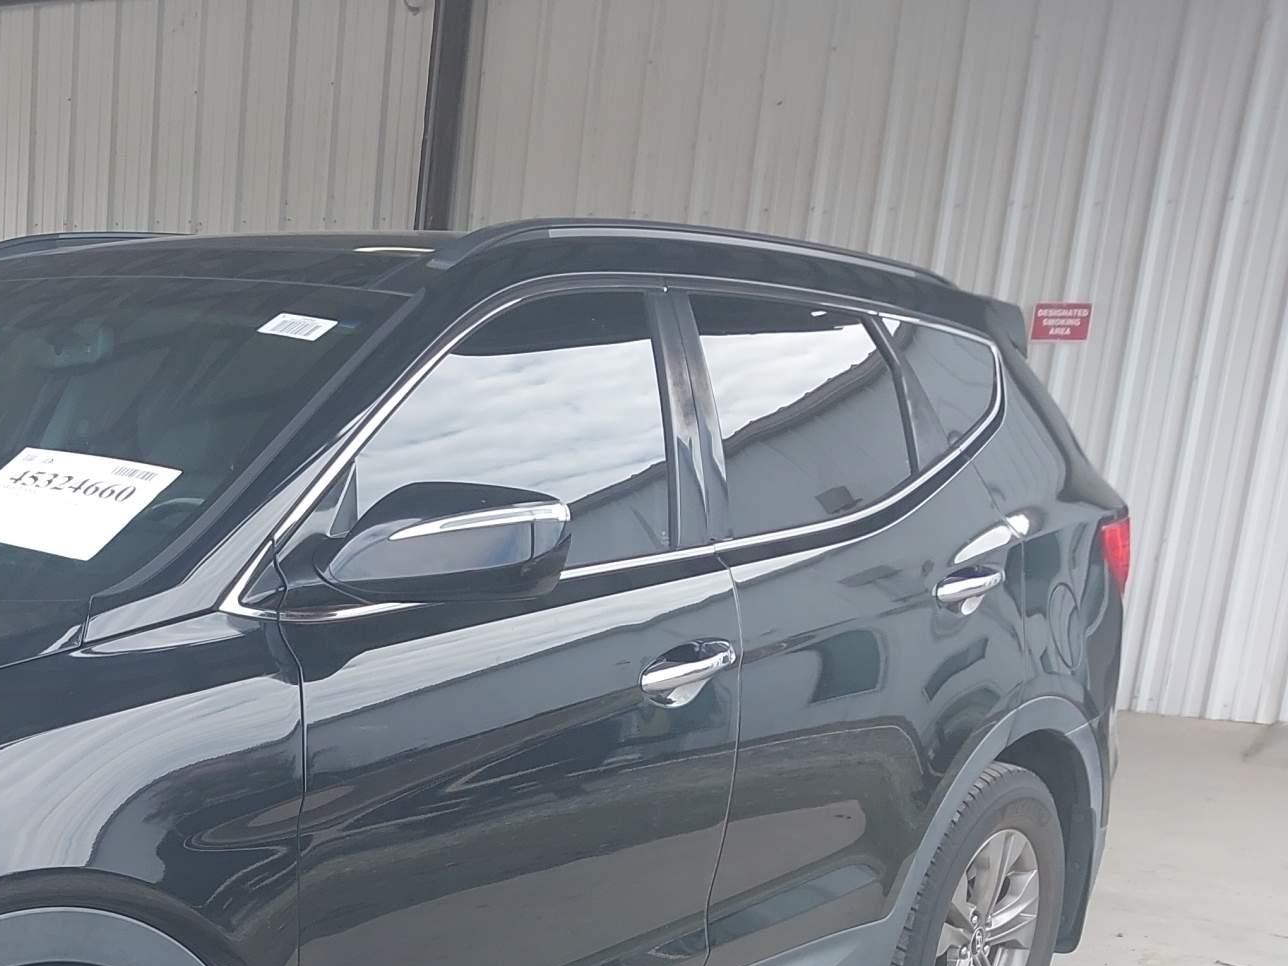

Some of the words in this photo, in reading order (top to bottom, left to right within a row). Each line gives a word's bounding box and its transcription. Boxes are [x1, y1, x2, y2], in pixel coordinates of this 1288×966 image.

[1037, 308, 1089, 318] DESIGNATED
[1048, 327, 1072, 335] AREA
[9, 470, 137, 503] 45324660
